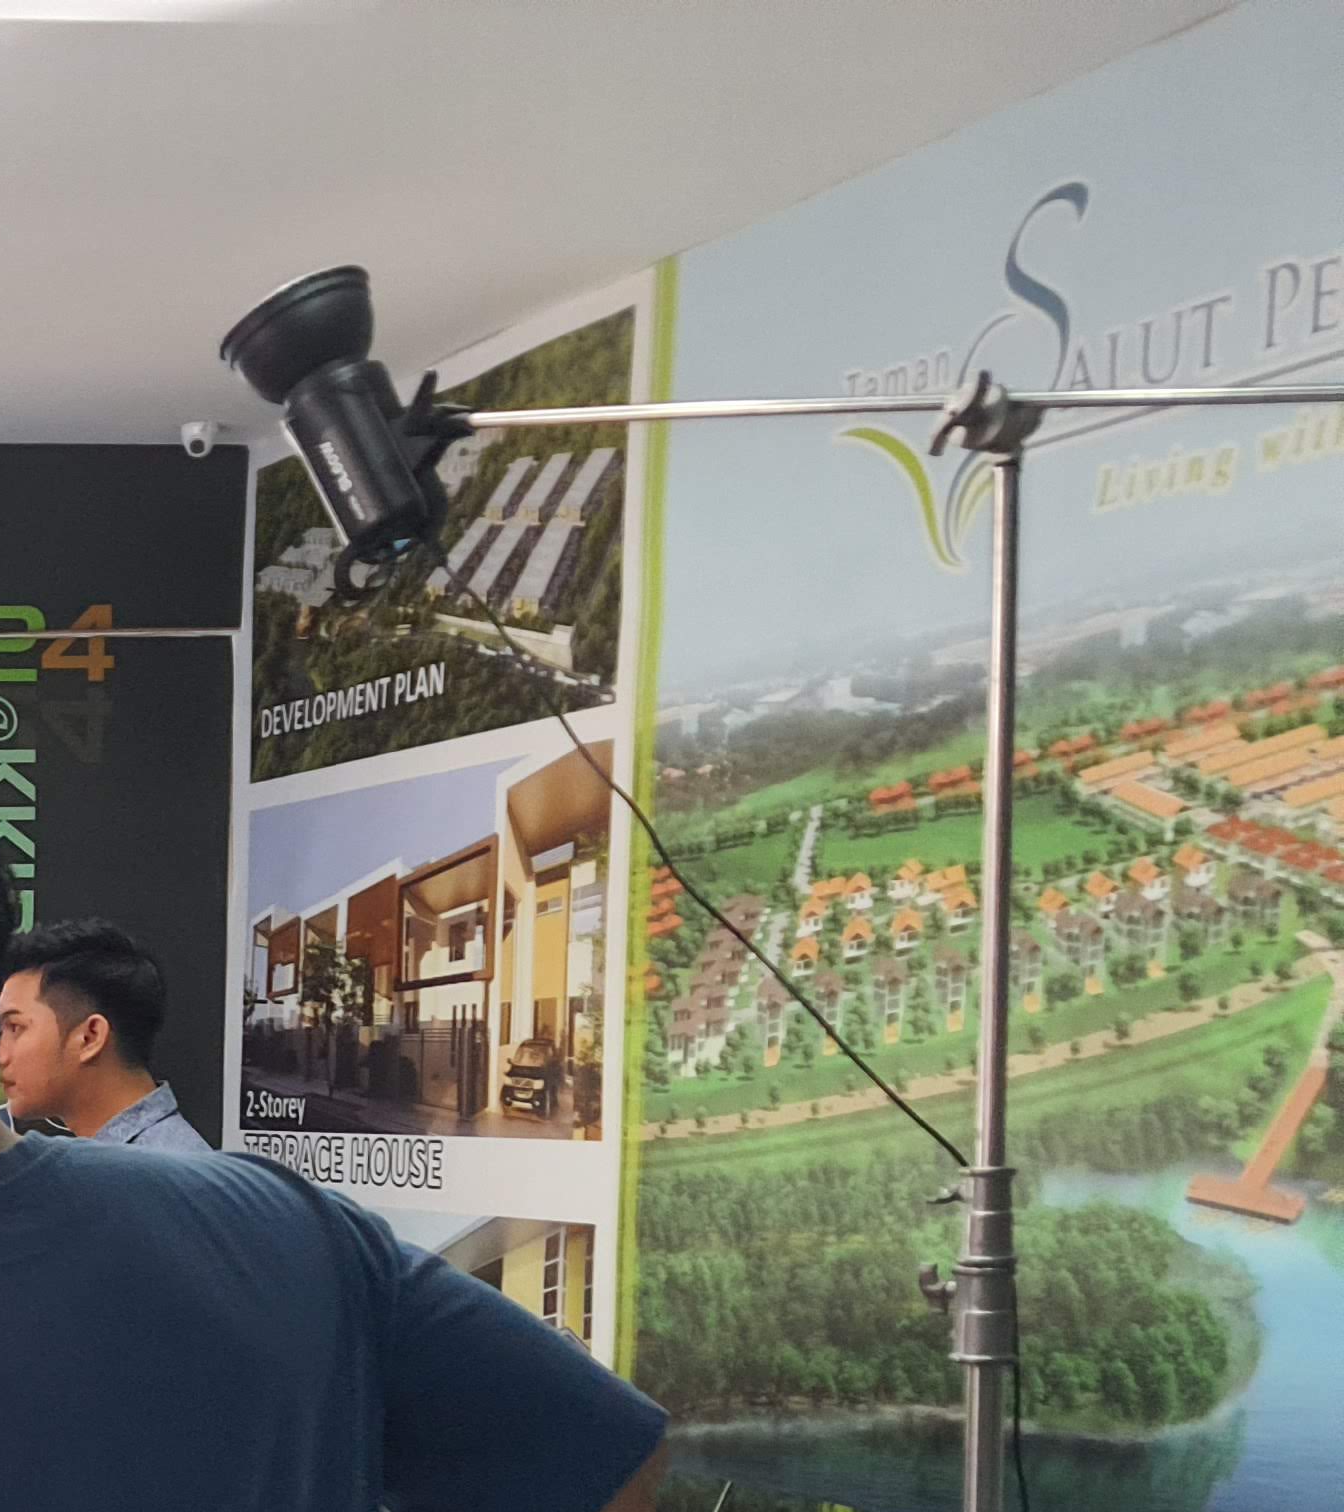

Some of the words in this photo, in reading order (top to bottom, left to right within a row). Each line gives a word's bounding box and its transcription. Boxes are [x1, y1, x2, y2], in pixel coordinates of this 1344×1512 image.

[847, 351, 949, 396] Taman
[1095, 447, 1235, 508] Living
[262, 676, 391, 739] DEVELOPMENT
[394, 661, 445, 706] PLAN
[246, 1090, 306, 1126] 2-Storey
[350, 1137, 443, 1190] HOUSE
